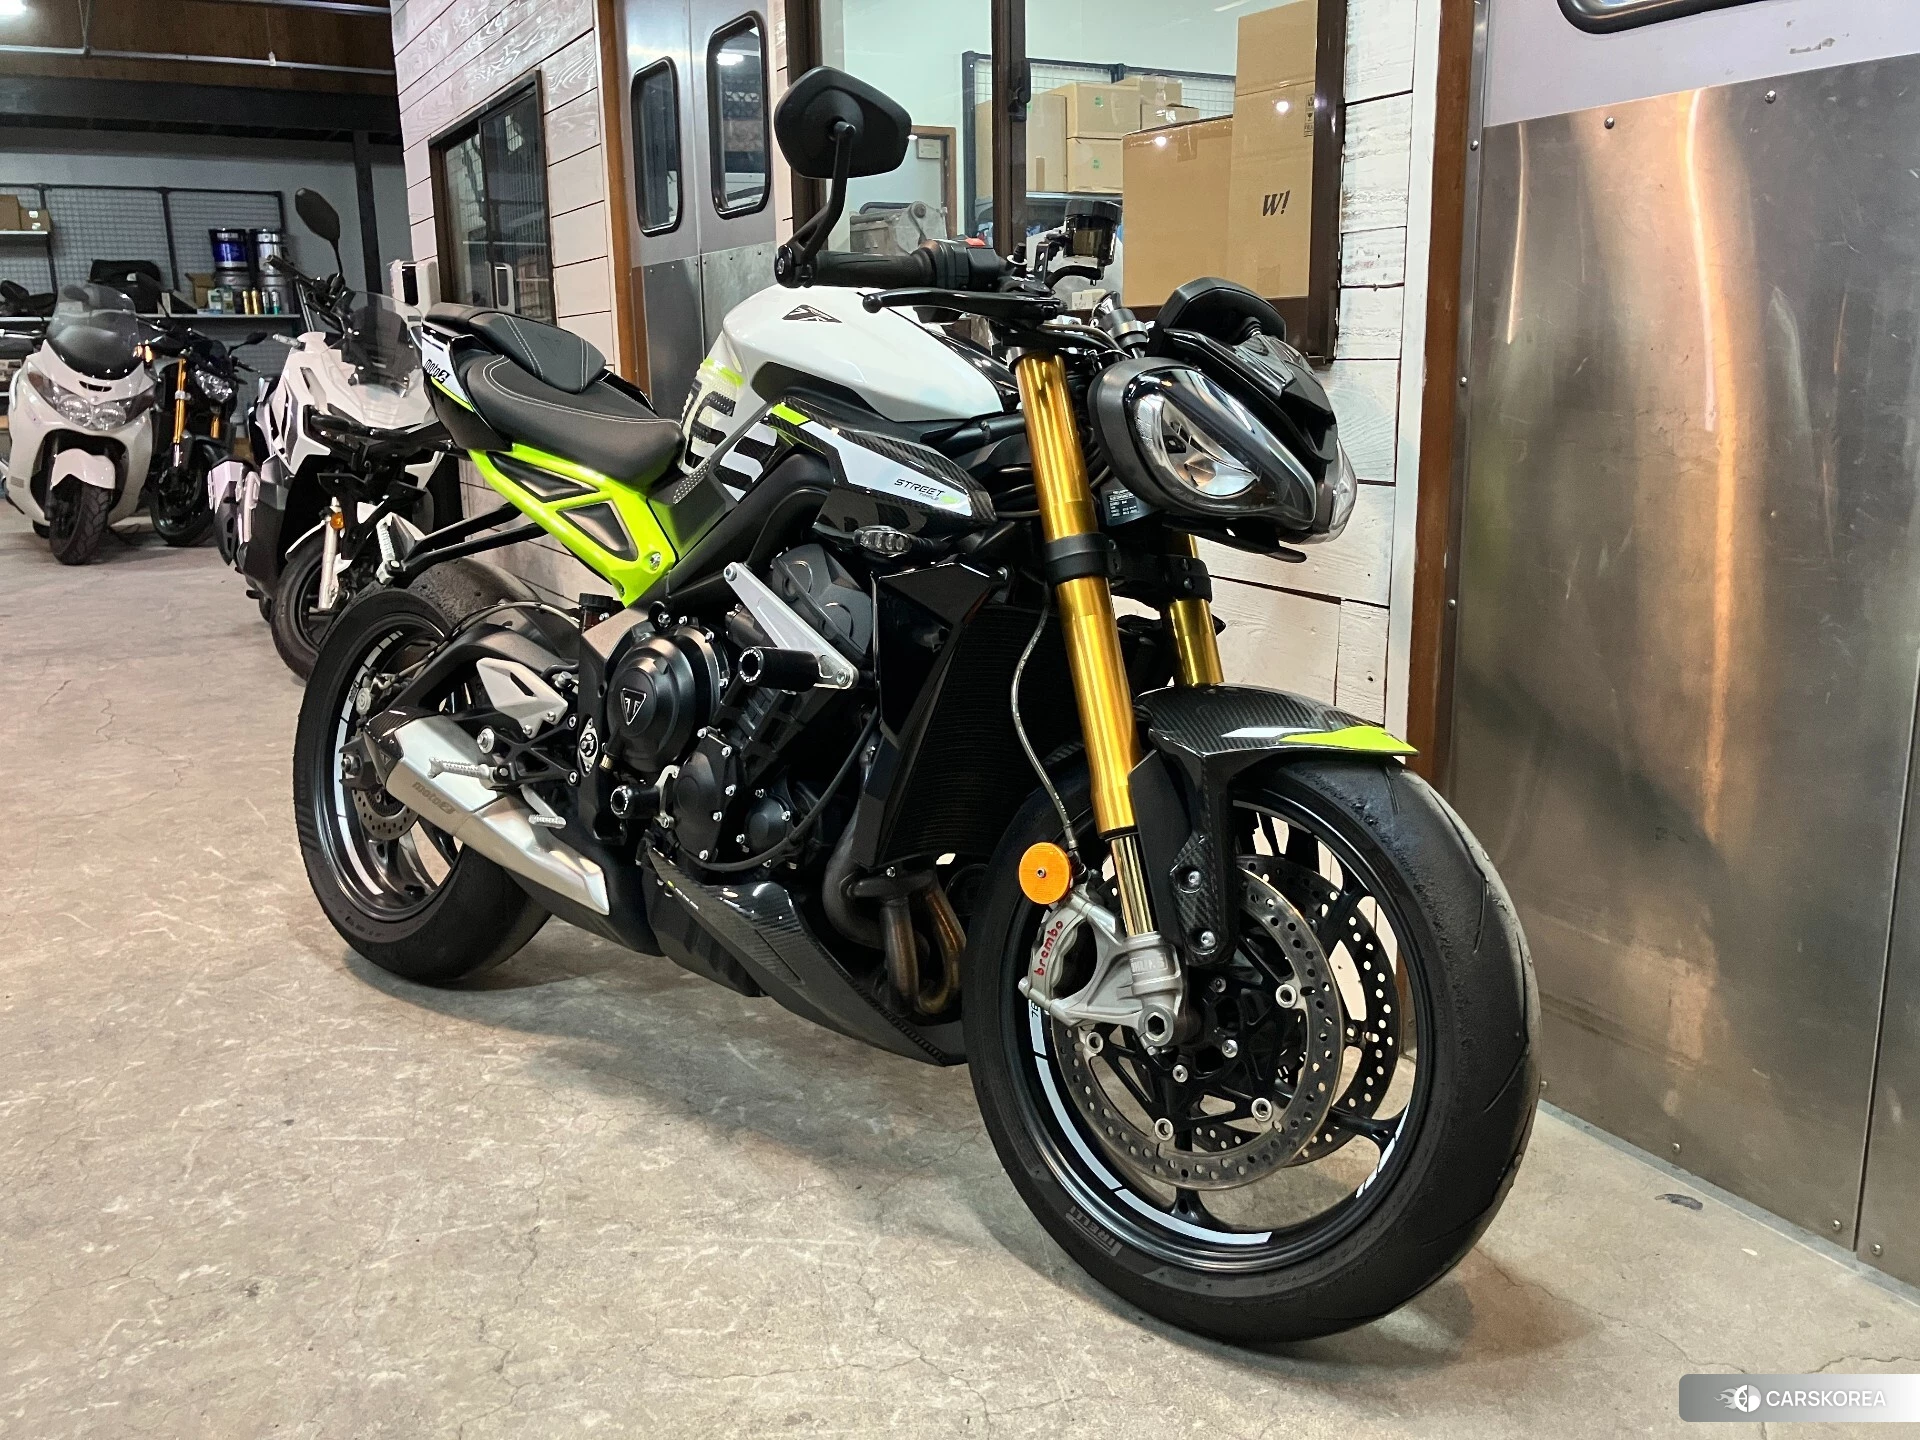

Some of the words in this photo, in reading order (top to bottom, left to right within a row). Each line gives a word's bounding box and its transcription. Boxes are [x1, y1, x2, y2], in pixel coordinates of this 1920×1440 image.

[1262, 189, 1291, 217] W!
[894, 478, 946, 497] STREET
[1033, 920, 1064, 976] brembo
[1065, 1205, 1123, 1257] PIRELLI
